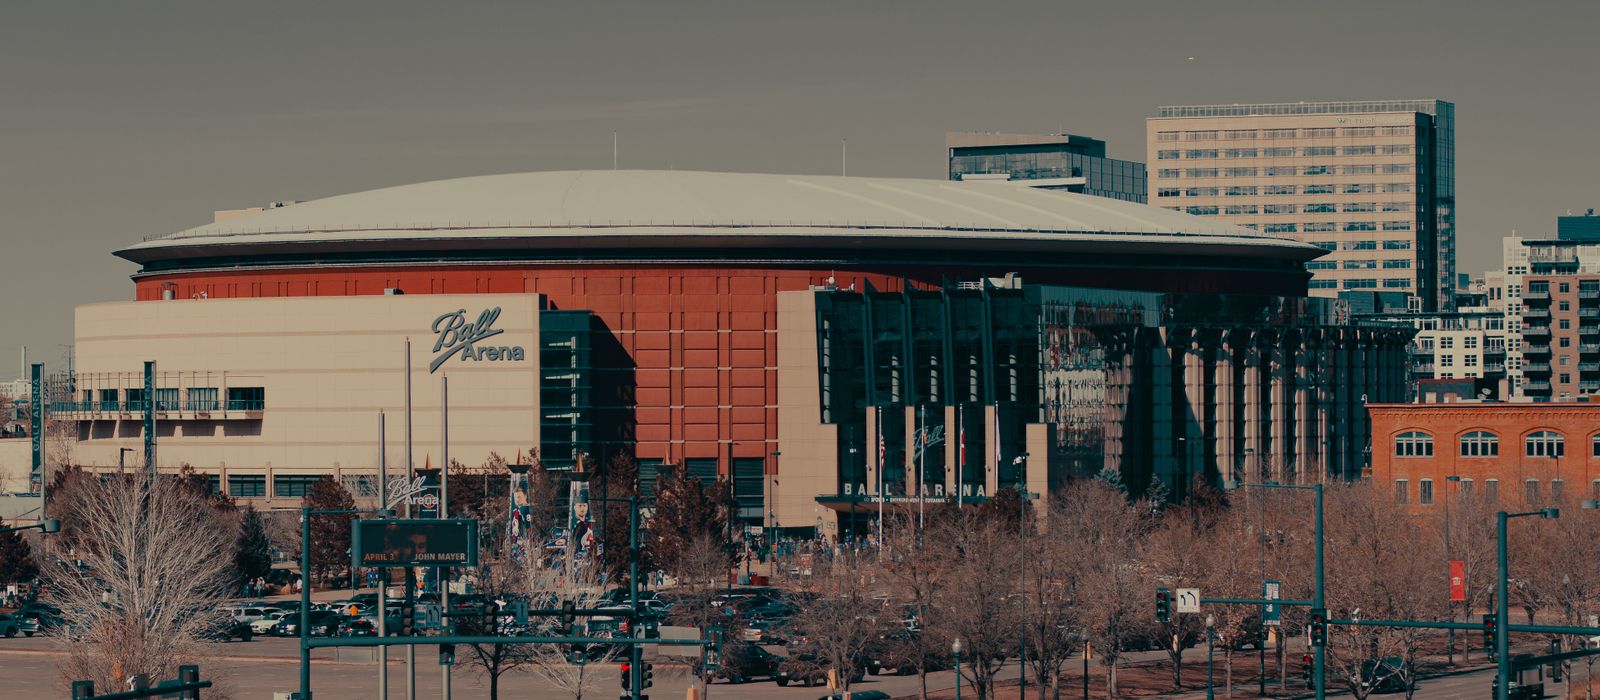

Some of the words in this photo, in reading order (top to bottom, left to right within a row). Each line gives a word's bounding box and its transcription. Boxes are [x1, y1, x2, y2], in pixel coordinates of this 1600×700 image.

[430, 306, 504, 374] Ball
[461, 341, 525, 361] Arena
[32, 378, 40, 418] ARENA
[386, 475, 428, 510] Ball
[404, 495, 440, 505] Arena
[844, 483, 893, 496] BALL
[920, 483, 986, 497] ARENA
[364, 553, 388, 561] APRIL
[390, 553, 395, 561] 3
[414, 553, 436, 561] JOHN
[438, 553, 466, 561] MAYER
